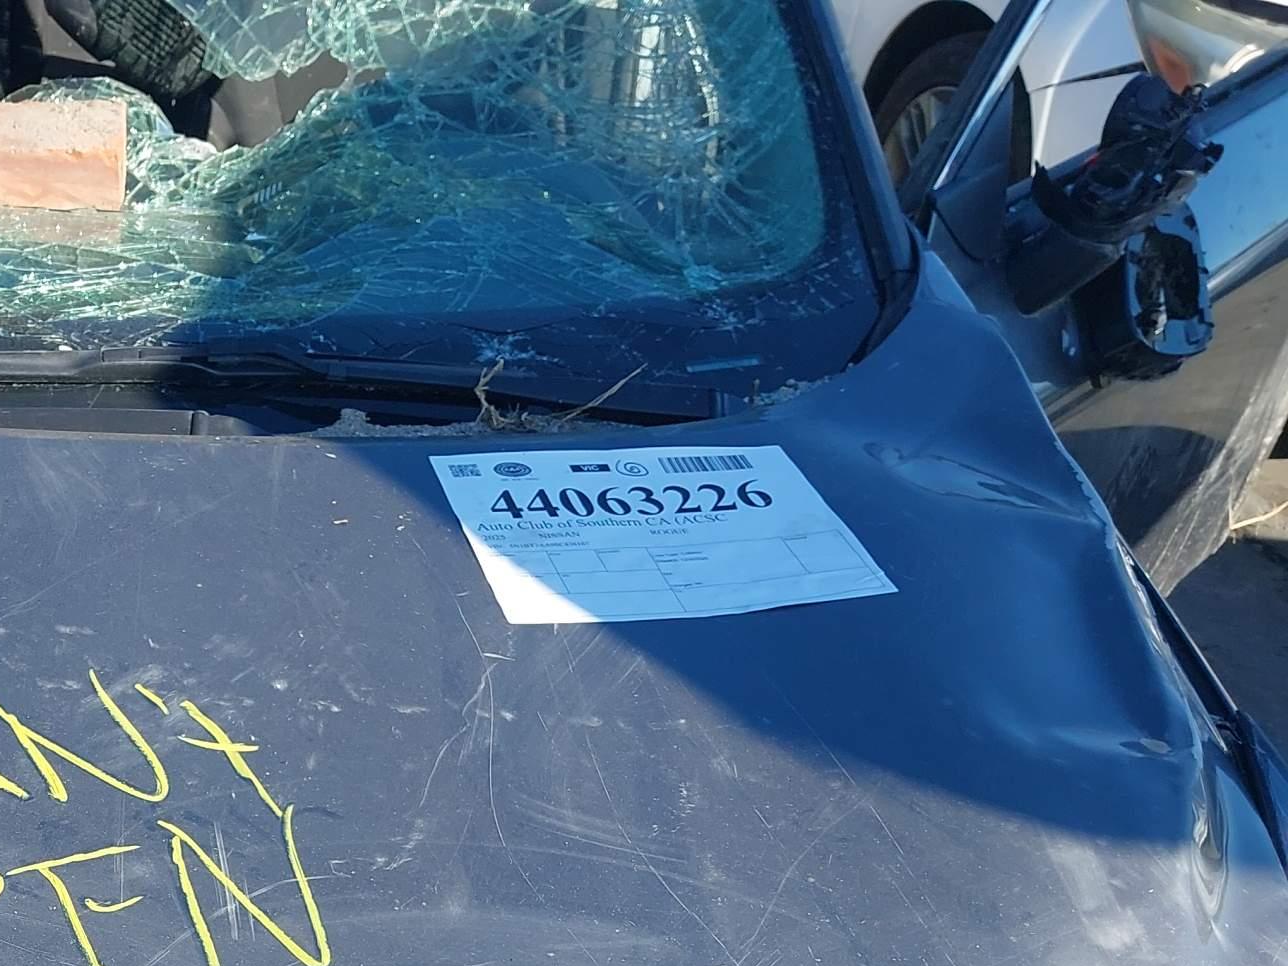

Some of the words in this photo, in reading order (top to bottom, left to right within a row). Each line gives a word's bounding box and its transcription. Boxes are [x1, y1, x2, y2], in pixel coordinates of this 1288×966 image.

[490, 479, 773, 519] 44063226
[477, 522, 513, 532] Auto
[516, 520, 553, 530] Club
[557, 519, 573, 529] of
[575, 517, 643, 529] Southern
[644, 516, 672, 527] CA
[674, 513, 729, 526] (ACSC
